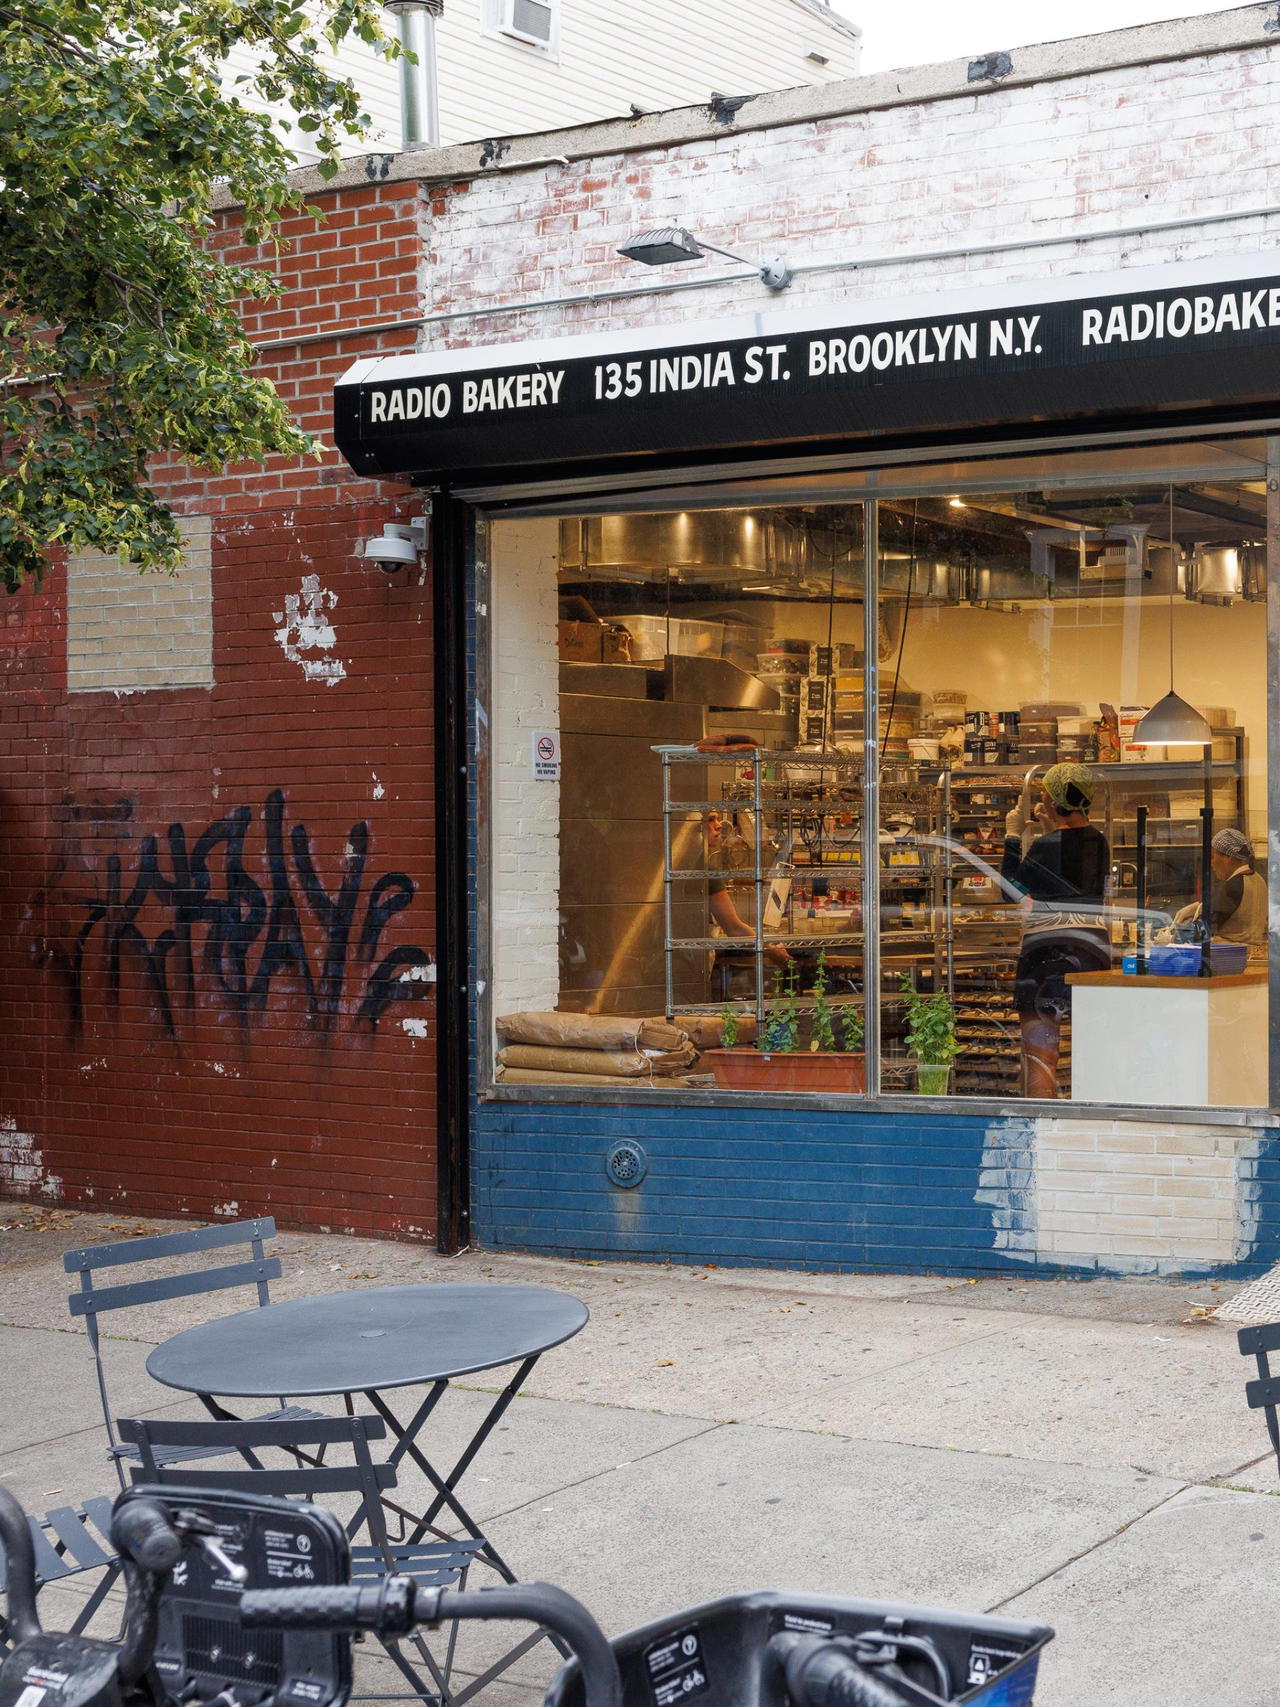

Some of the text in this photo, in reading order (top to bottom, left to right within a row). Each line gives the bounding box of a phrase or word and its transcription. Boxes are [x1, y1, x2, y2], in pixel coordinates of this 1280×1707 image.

[371, 384, 451, 423] RADIO
[462, 370, 566, 414] BAKERY
[594, 362, 643, 400] 135
[649, 351, 736, 394] INDIA
[743, 344, 791, 384] ST.
[808, 322, 978, 377] BROOKLYN
[989, 315, 1043, 357] N.Y.
